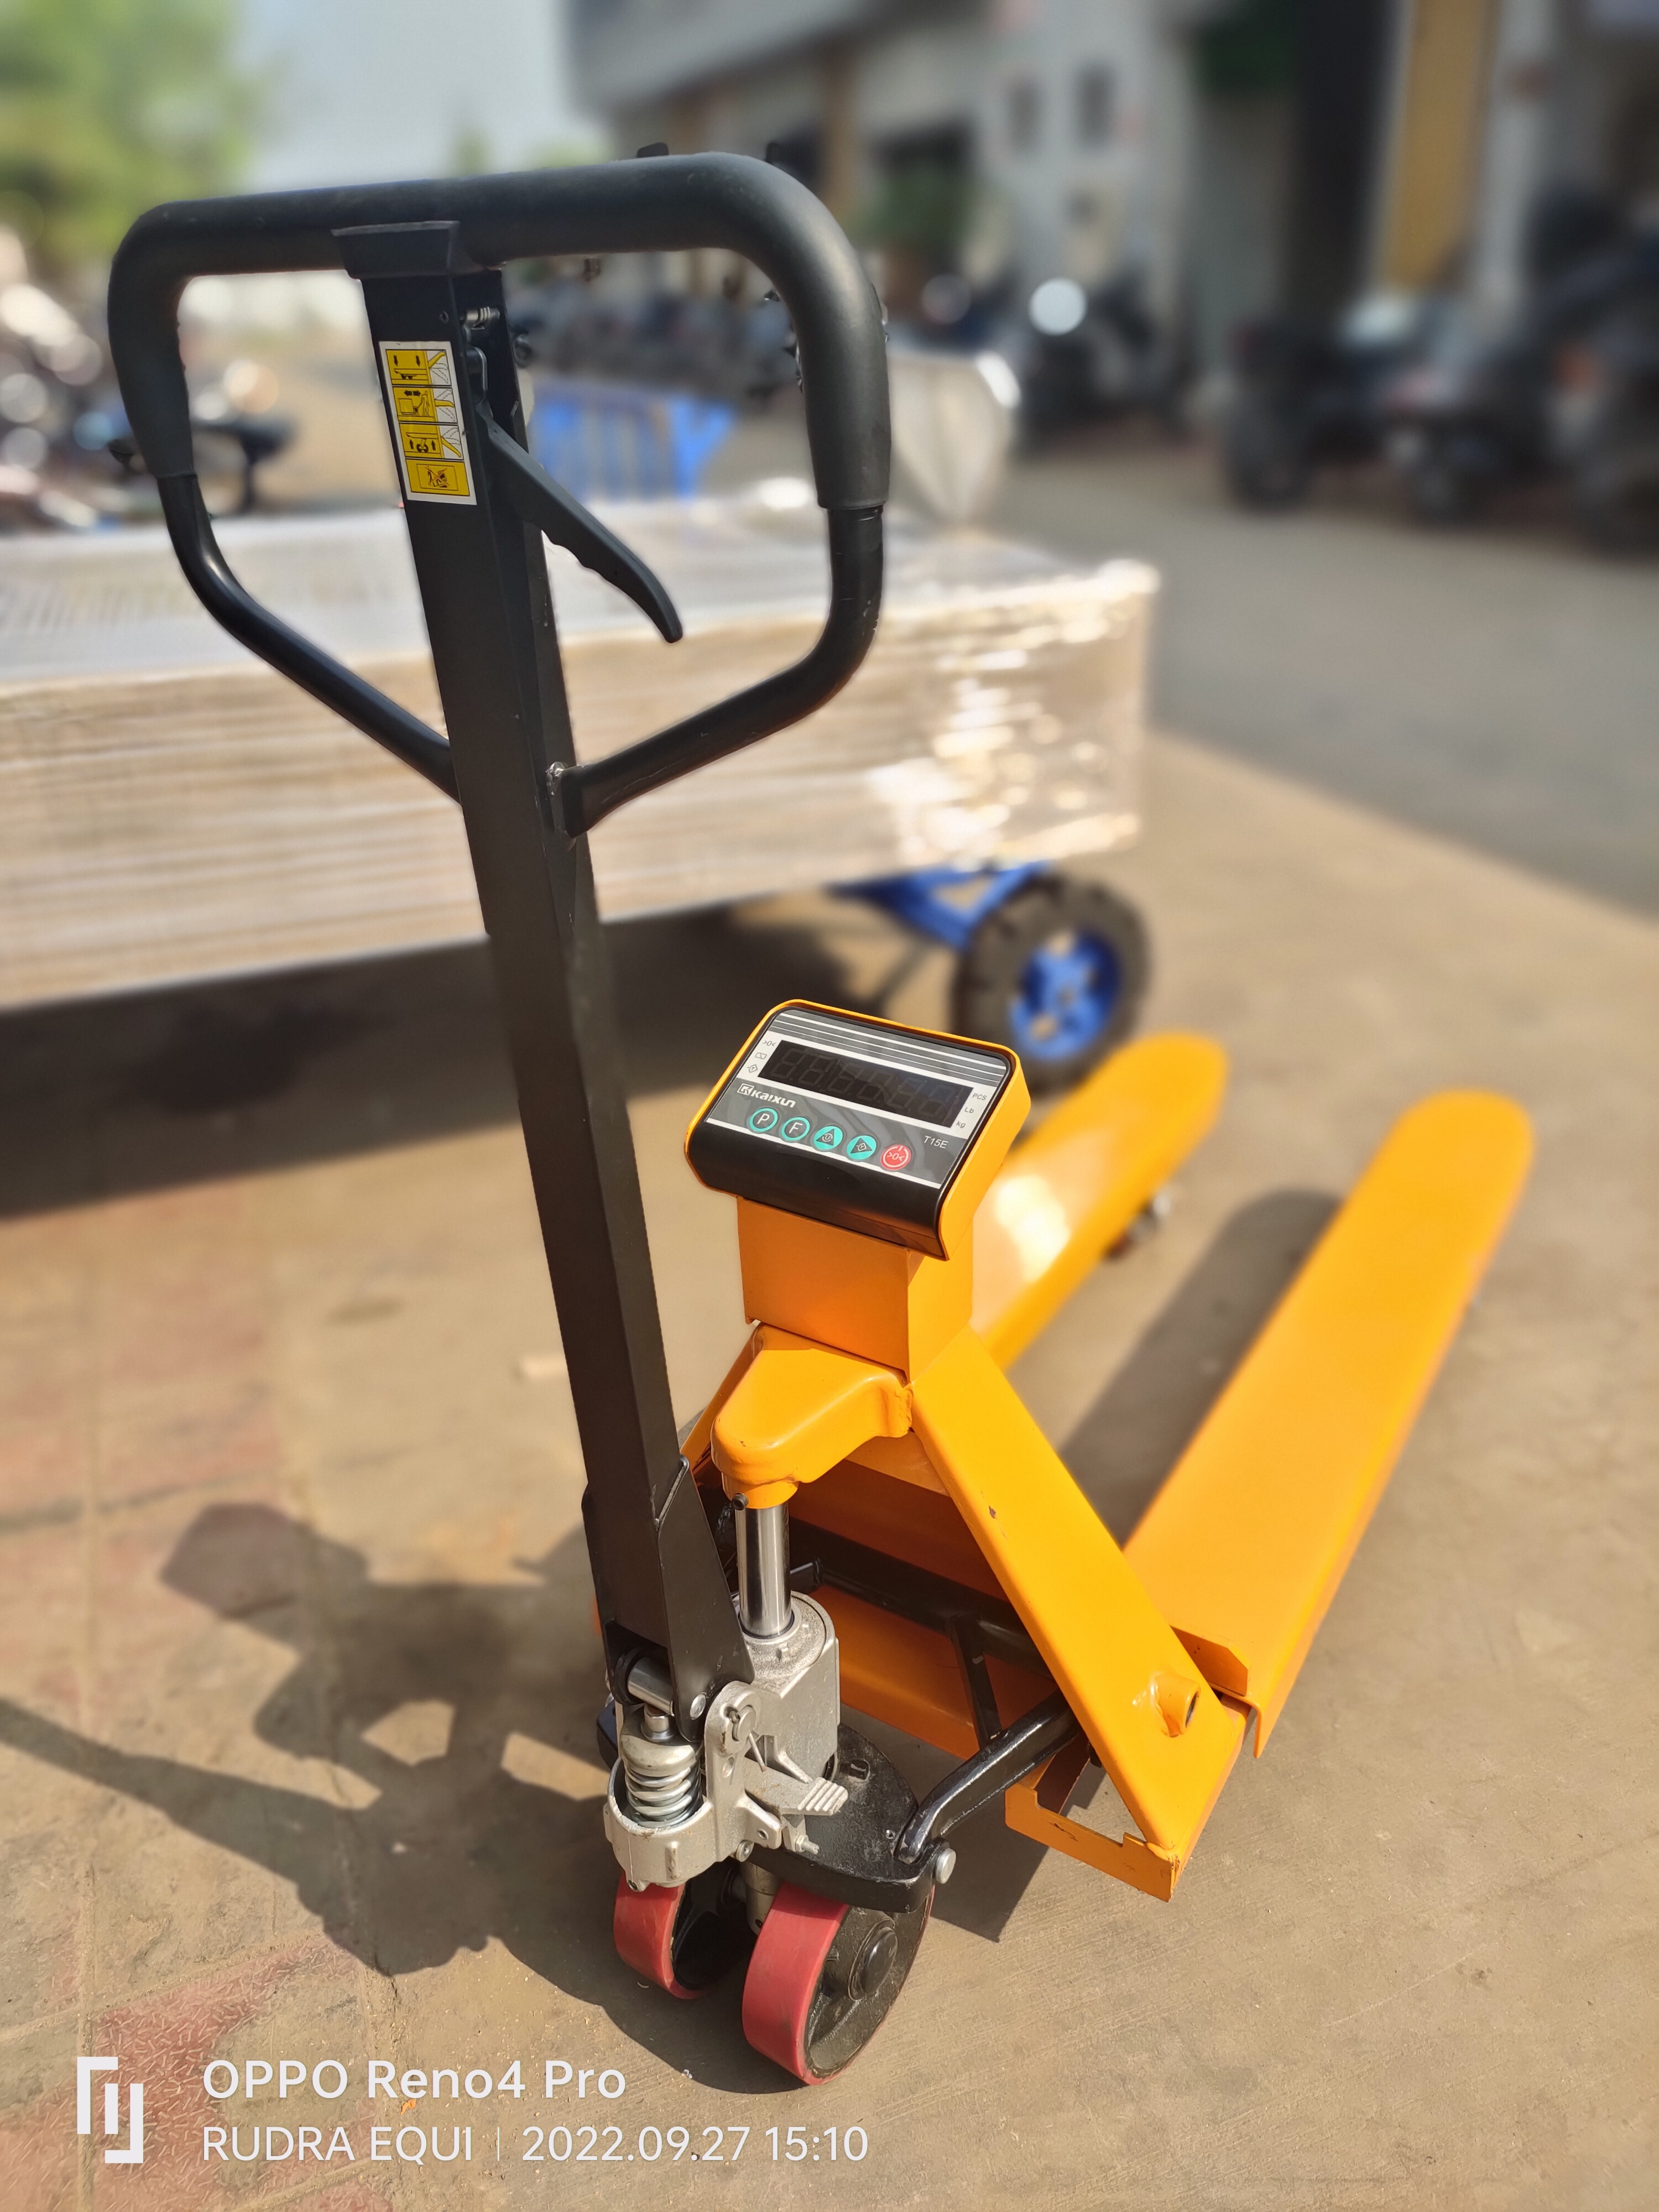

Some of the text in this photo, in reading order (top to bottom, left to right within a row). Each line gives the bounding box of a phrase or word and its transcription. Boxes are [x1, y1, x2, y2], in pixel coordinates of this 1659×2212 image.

[757, 1113, 770, 1124] P
[789, 1122, 804, 1134] F
[924, 1135, 949, 1149] T15E
